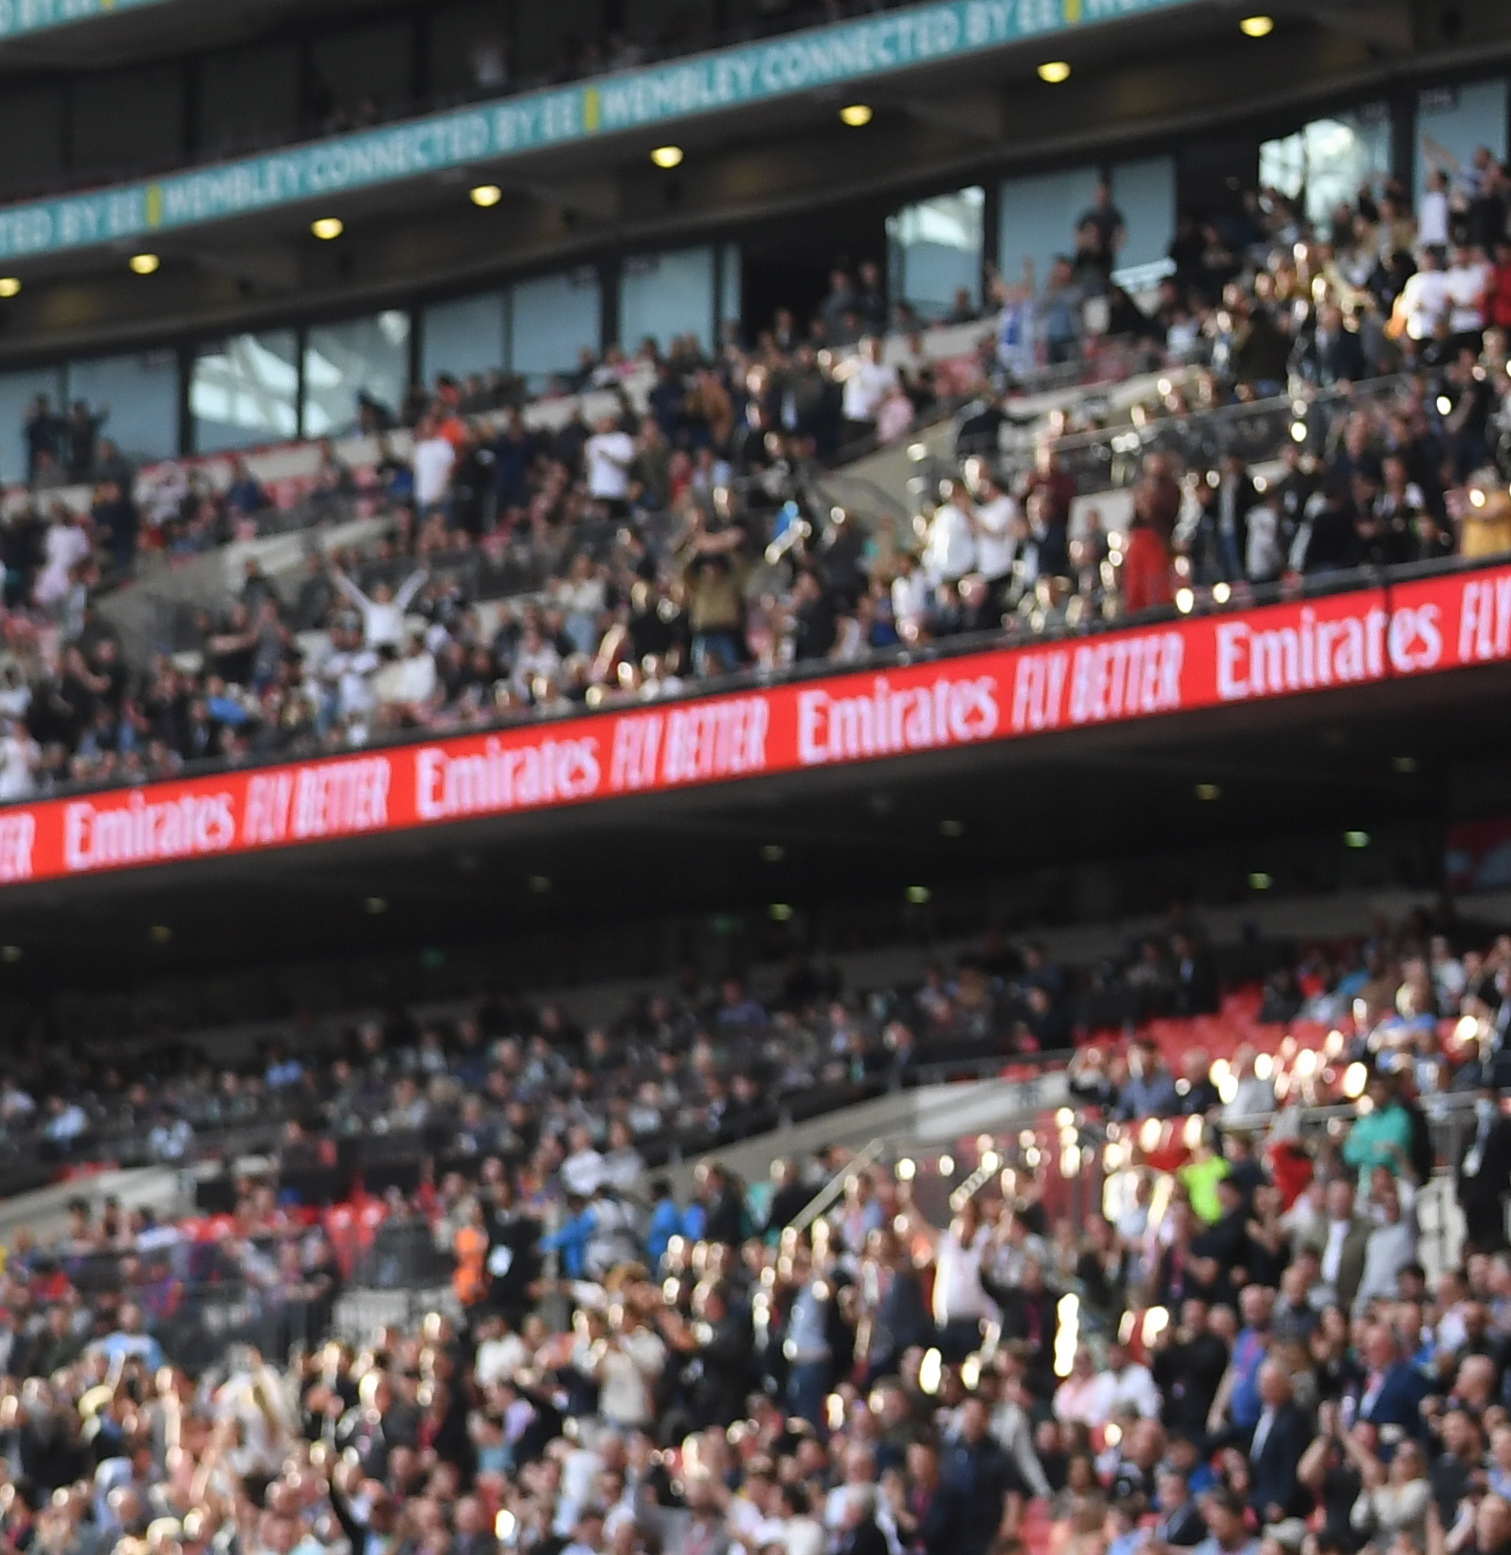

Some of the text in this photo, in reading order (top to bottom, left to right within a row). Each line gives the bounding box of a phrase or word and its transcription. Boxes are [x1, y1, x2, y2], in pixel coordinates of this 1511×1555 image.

[603, 55, 754, 123] WEMBLEY
[761, 11, 958, 89] CONNECTED
[966, 0, 1012, 45] BY
[58, 197, 105, 242] BY
[167, 153, 305, 220] WEMBLEY
[311, 112, 488, 187] CONNECTED
[495, 101, 539, 147] BY
[797, 631, 1185, 766] Emirates FLY BETTER
[1215, 603, 1442, 700] Emirates
[64, 756, 391, 872] Emirates FLY BETTER
[415, 697, 769, 820] Emirates FLY BETTER
